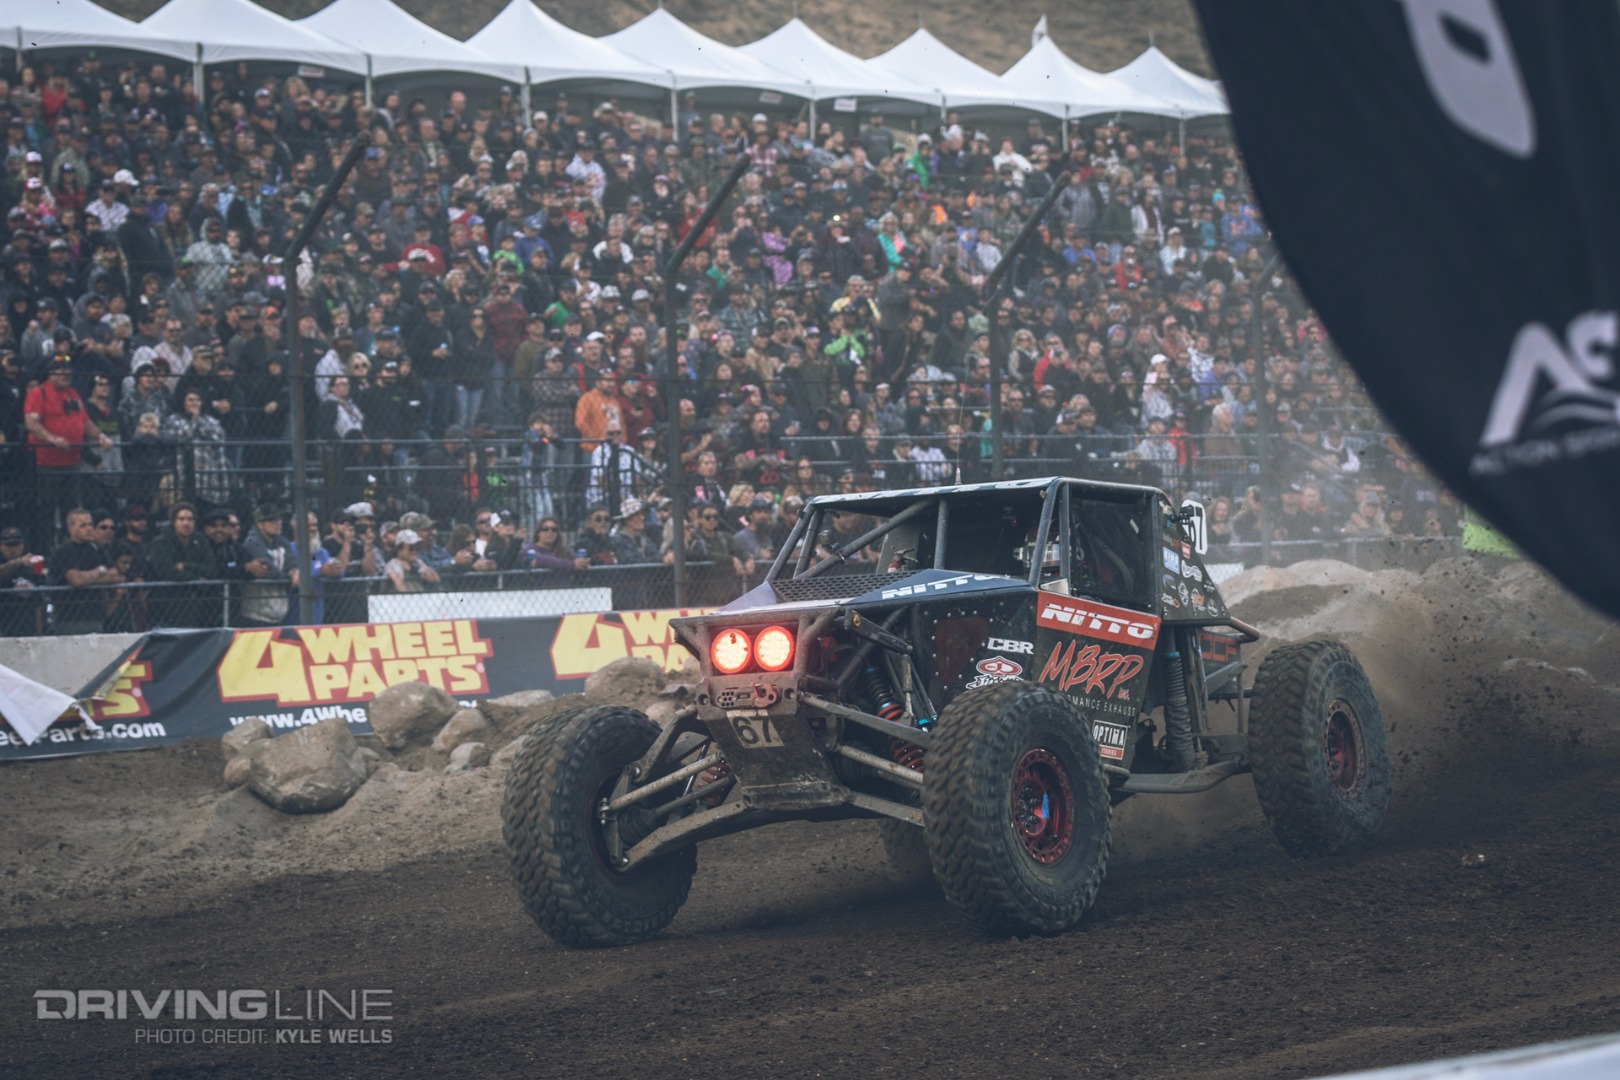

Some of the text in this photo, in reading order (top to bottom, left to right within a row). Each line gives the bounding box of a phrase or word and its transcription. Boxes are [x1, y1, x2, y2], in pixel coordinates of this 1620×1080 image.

[1041, 603, 1154, 639] NITTO
[218, 620, 487, 702] 4 WHEEL
[987, 637, 1034, 655] CBR
[309, 655, 481, 700] PARTS
[1038, 639, 1144, 699] MBRP
[1067, 694, 1136, 716] MANCE EXHAUST
[732, 710, 773, 744] 67
[1092, 724, 1125, 746] OPTIMA
